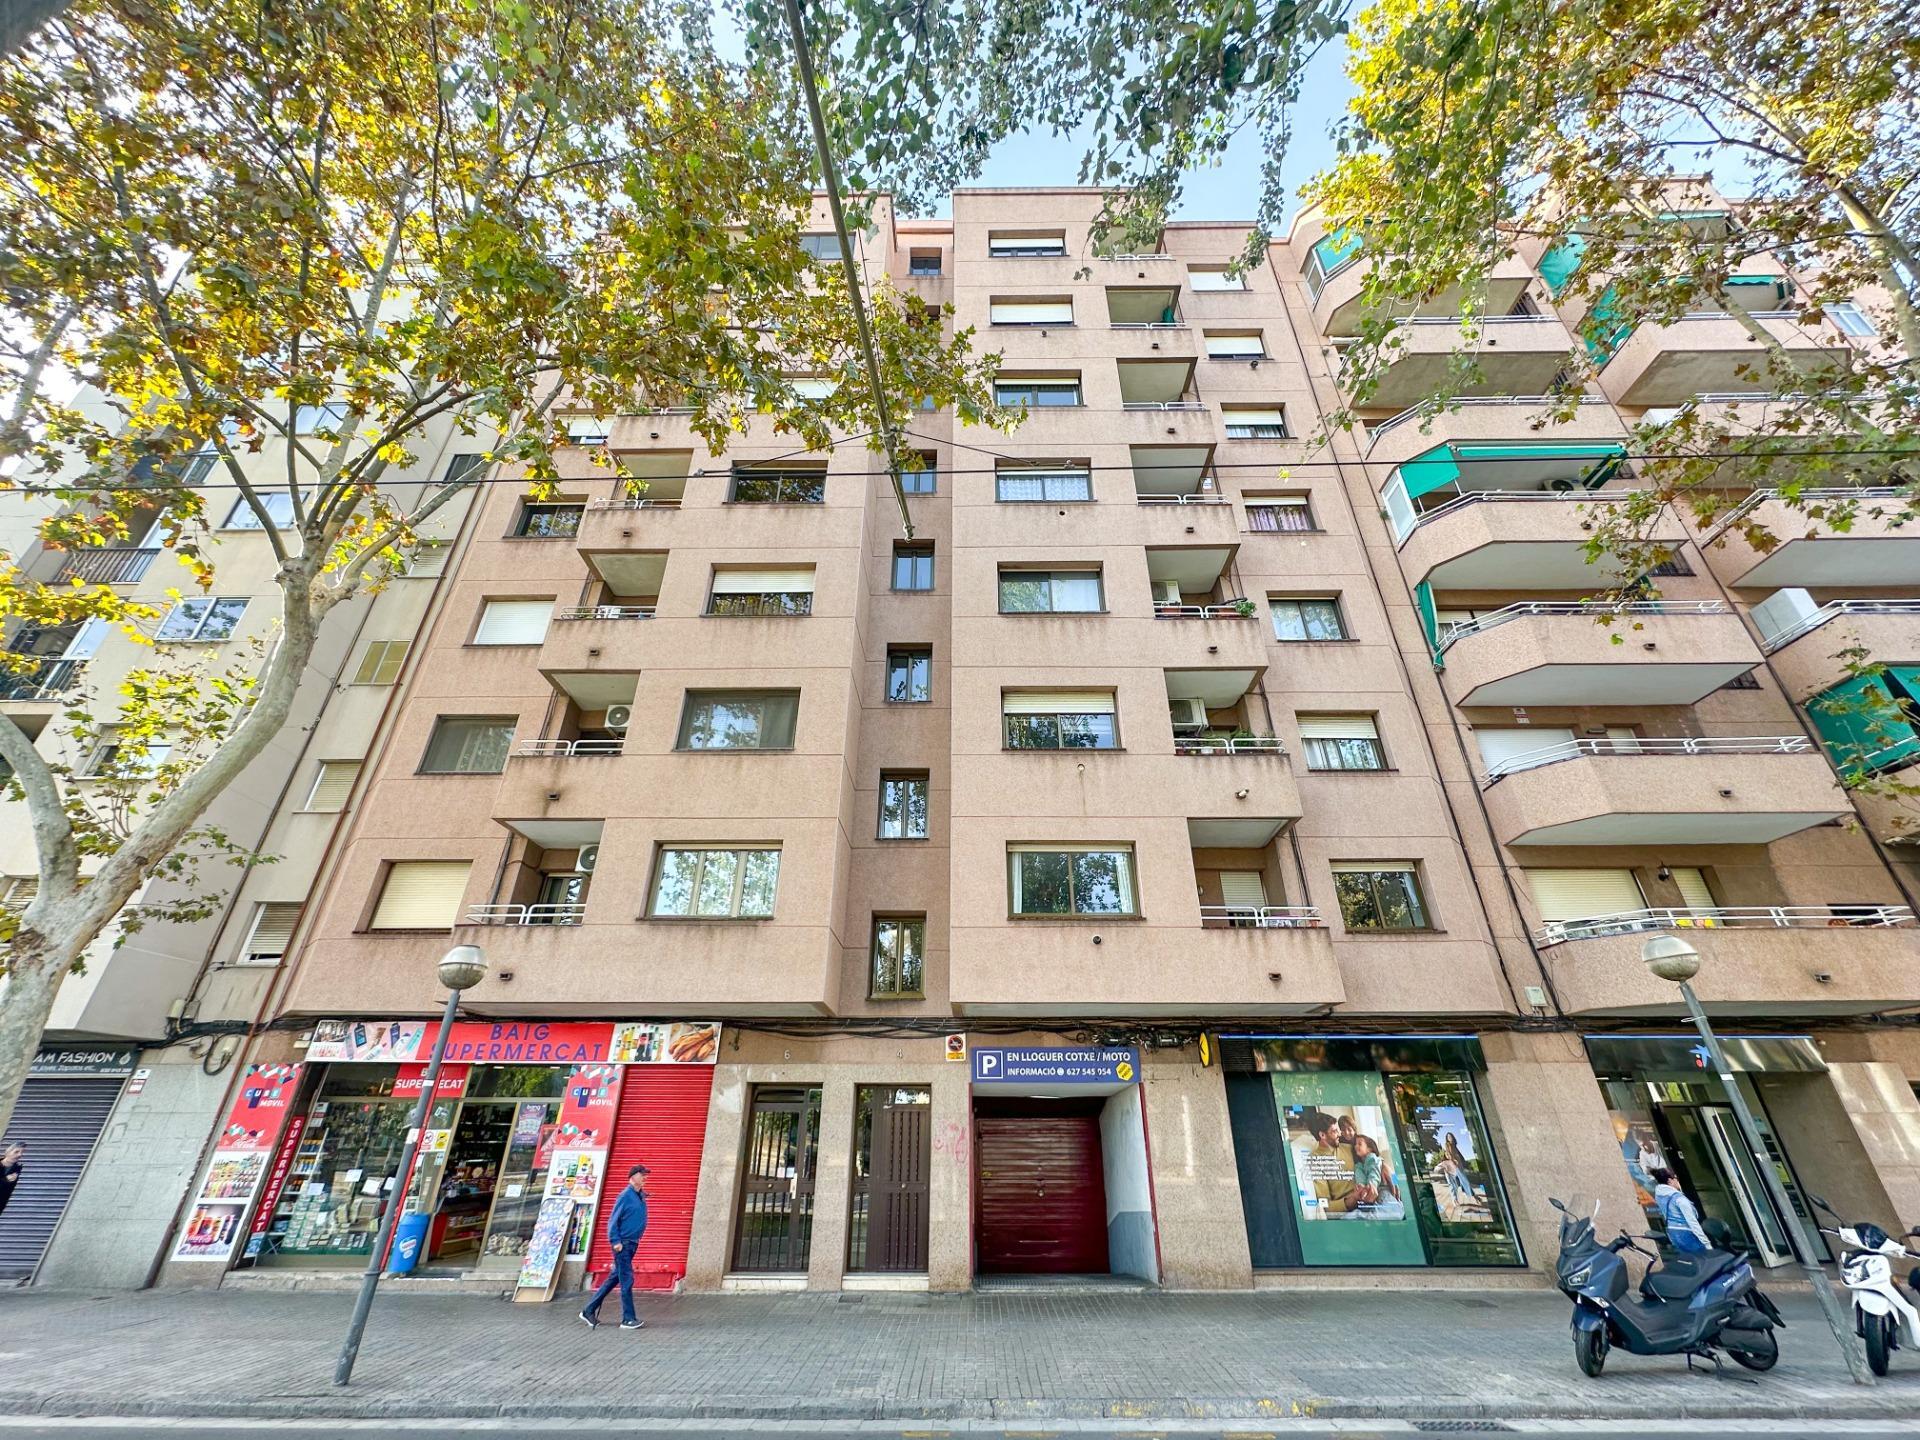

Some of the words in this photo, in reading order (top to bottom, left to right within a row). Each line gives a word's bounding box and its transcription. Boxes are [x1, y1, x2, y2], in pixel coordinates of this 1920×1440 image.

[490, 1024, 550, 1041] BAIG
[57, 1051, 117, 1063] FASHION
[784, 1049, 791, 1060] 6
[897, 1048, 904, 1059] 4
[1006, 1052, 1019, 1062] EN
[1021, 1052, 1063, 1062] LLOGUER
[1065, 1052, 1095, 1062] COTXE
[1096, 1052, 1101, 1062] /
[1102, 1052, 1131, 1062] MOTO
[982, 1055, 997, 1075] P
[1007, 1066, 1056, 1076] INFORMACIÓ
[1066, 1067, 1080, 1076] 627
[1082, 1067, 1095, 1076] 545
[394, 1079, 465, 1089] SUPEECAT
[256, 1119, 302, 1233] SUPERMERCAT
